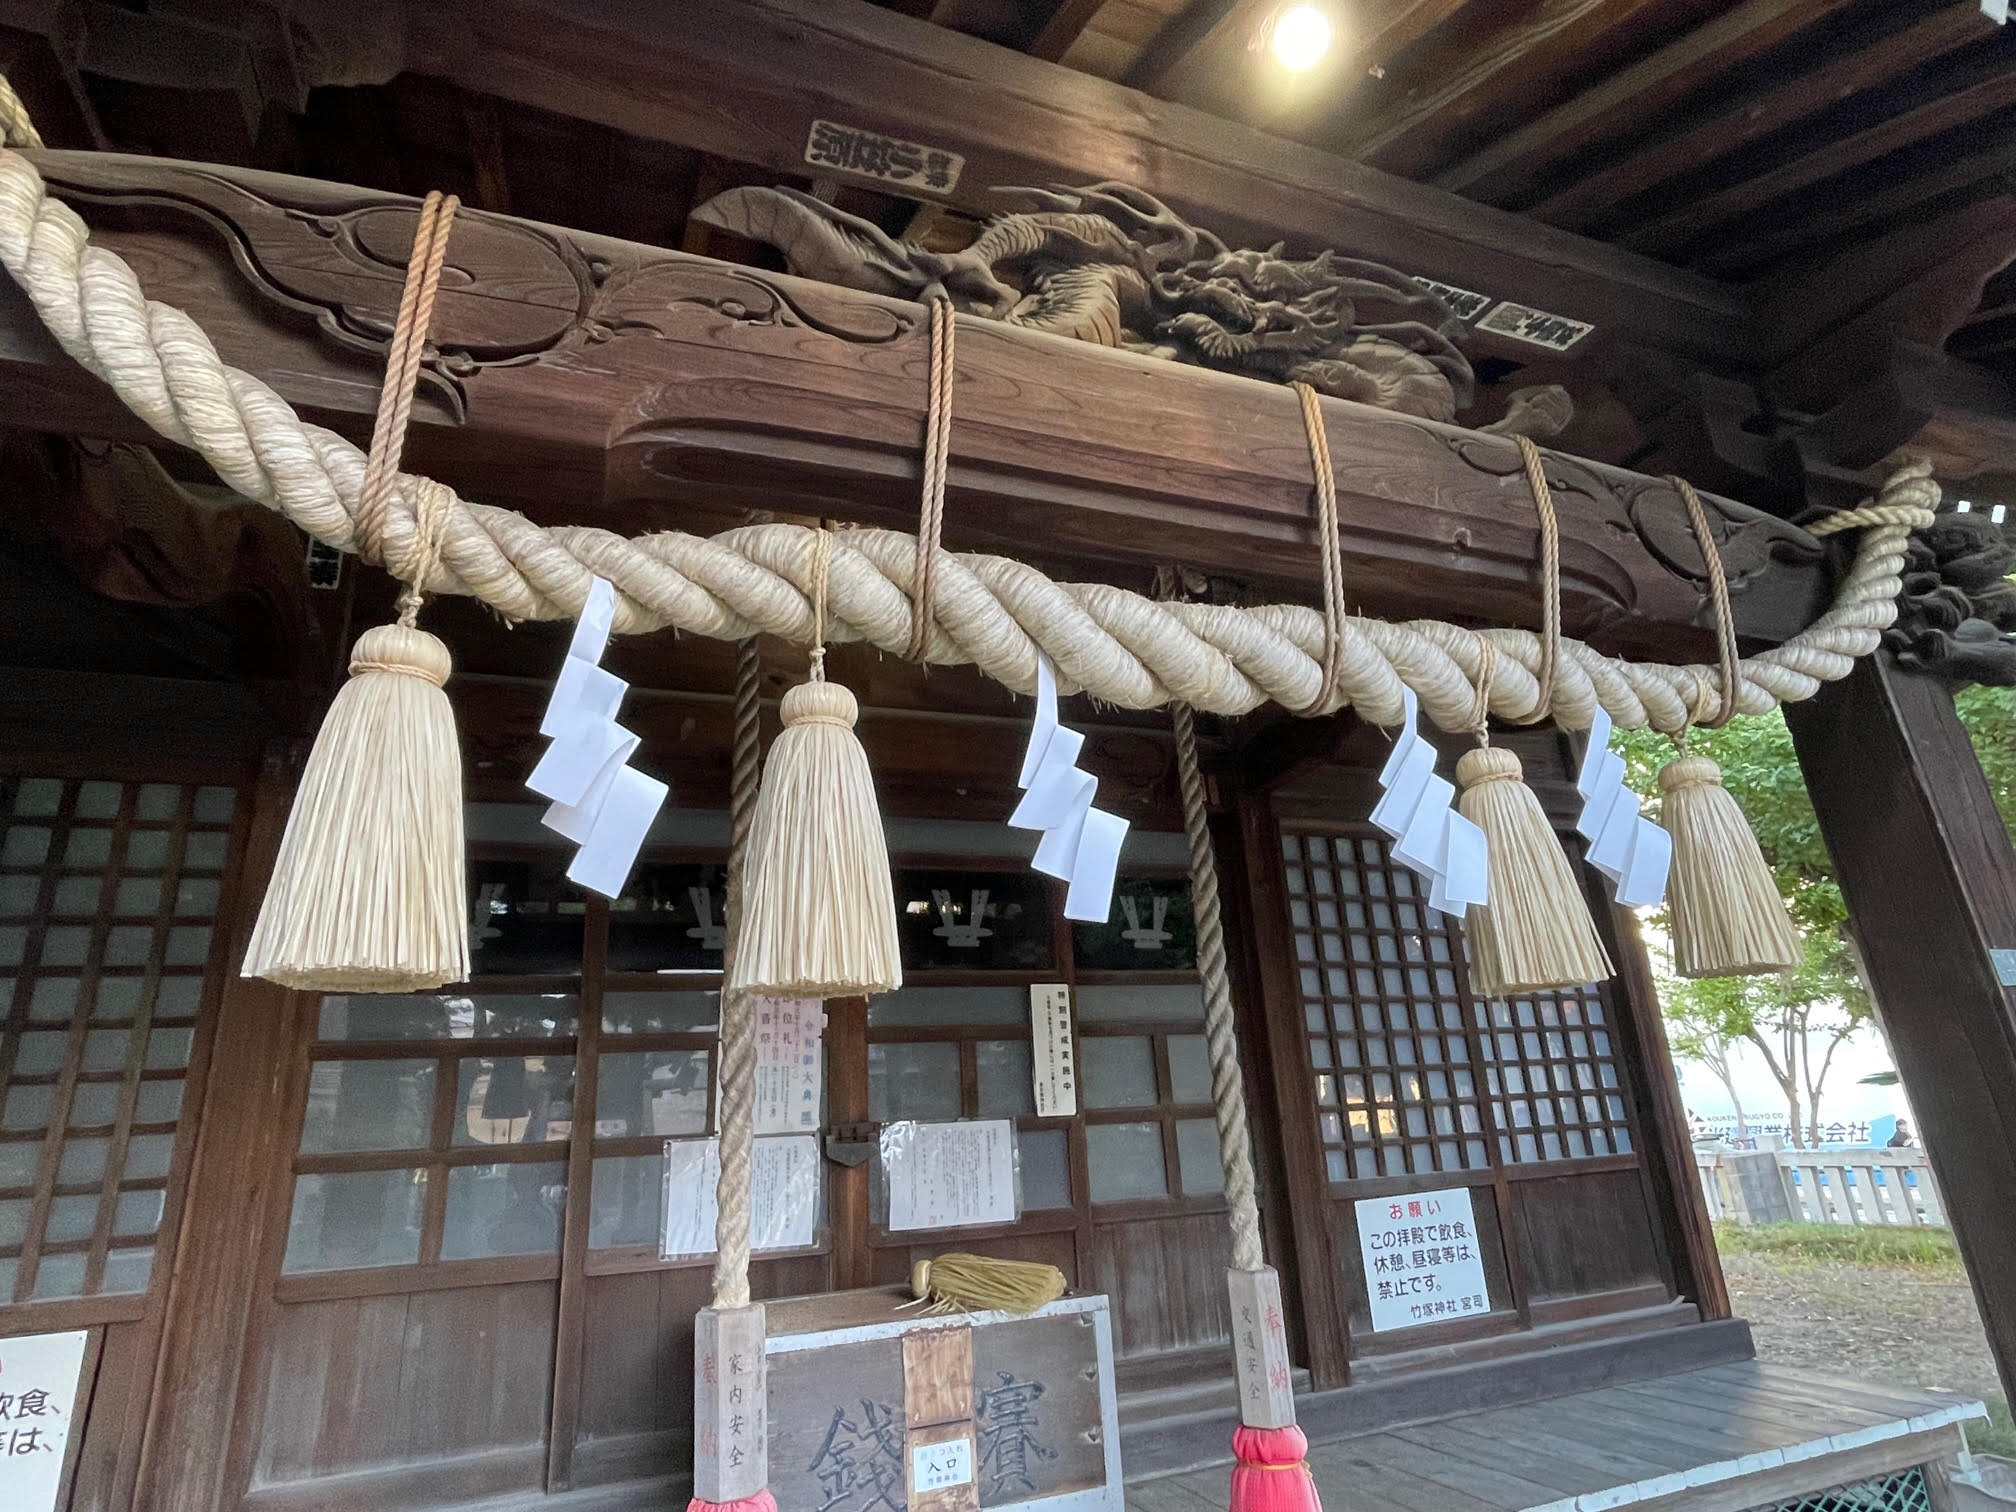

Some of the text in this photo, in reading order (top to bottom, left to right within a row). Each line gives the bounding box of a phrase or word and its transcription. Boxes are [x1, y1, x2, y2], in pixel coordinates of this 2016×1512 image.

[1388, 1199, 1442, 1220] お願い
[1370, 1221, 1473, 1250] この拝殿で飲食、
[1374, 1244, 1476, 1275] 休憩、昼寝等は、
[1377, 1273, 1442, 1301] 禁止です。
[728, 1353, 745, 1468] 家内安全
[0, 1426, 53, 1457] は、
[927, 1458, 957, 1474] 入口
